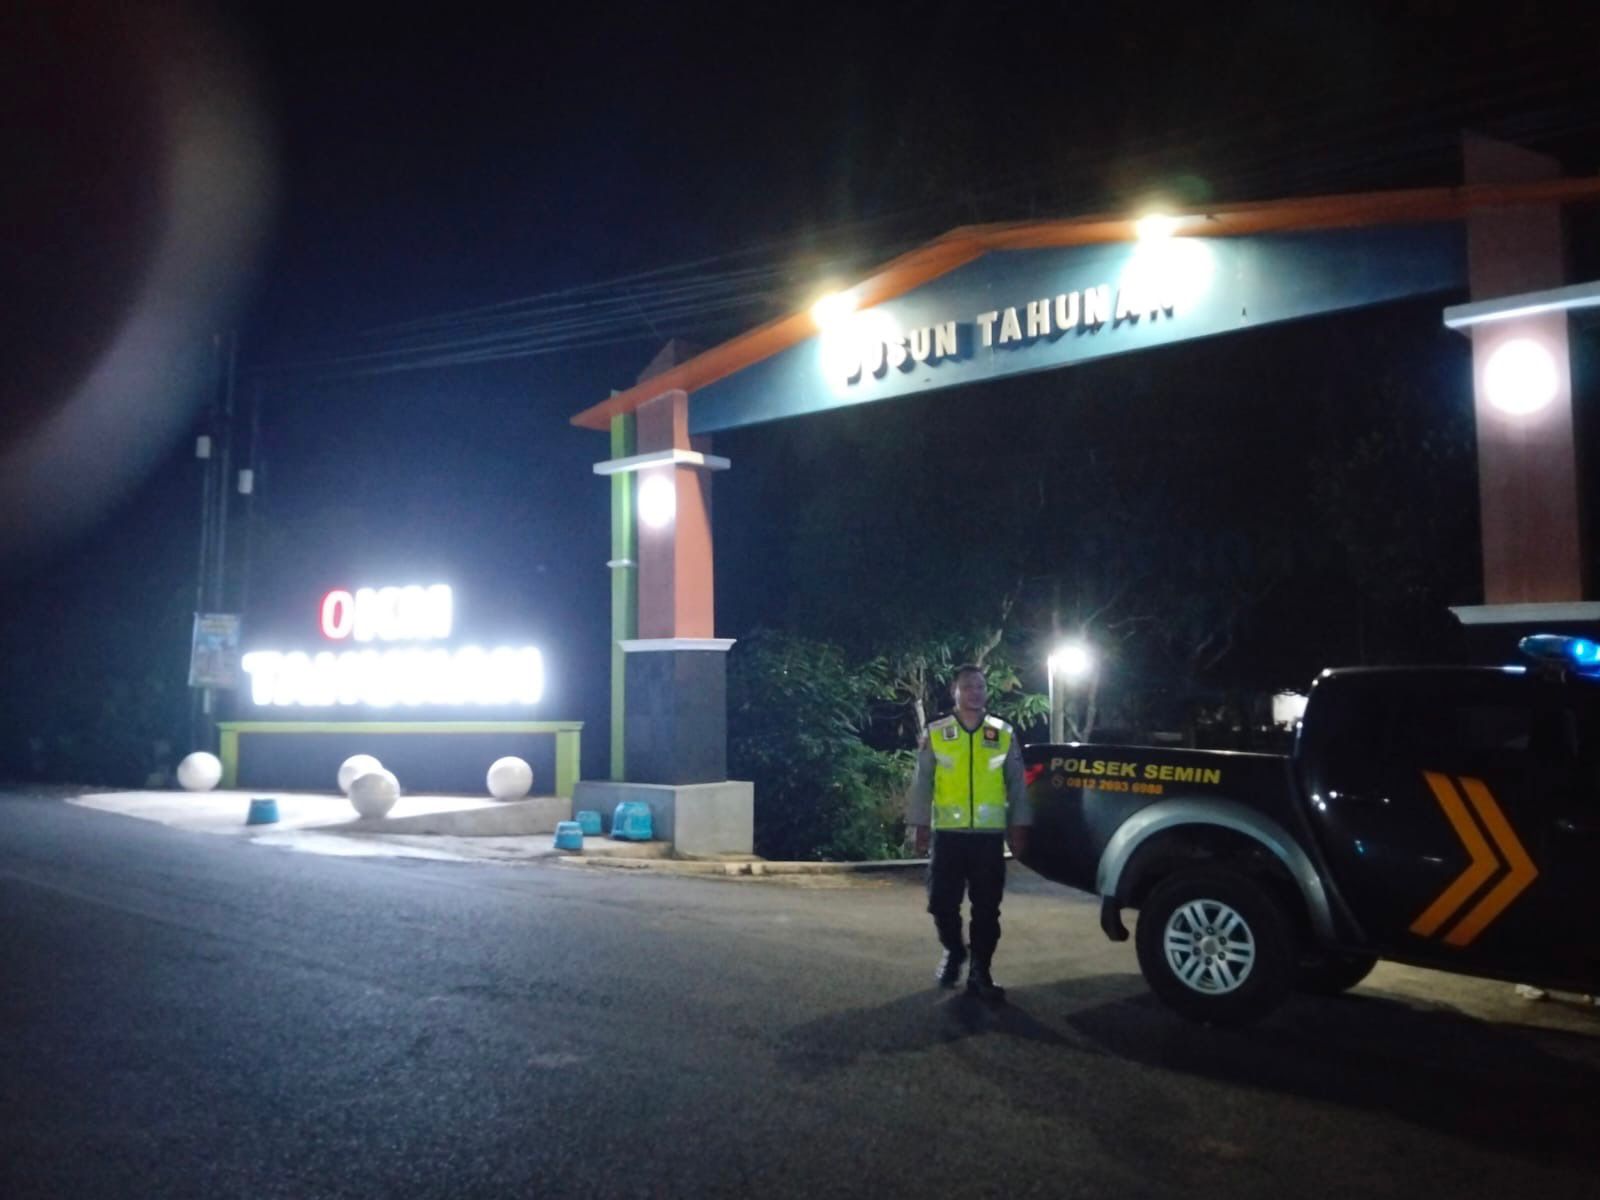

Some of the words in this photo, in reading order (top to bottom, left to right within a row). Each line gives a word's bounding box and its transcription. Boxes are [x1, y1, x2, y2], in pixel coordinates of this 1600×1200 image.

[837, 321, 957, 379] USUN
[1050, 758, 1137, 777] POLSEK
[1144, 764, 1221, 784] SEMIN
